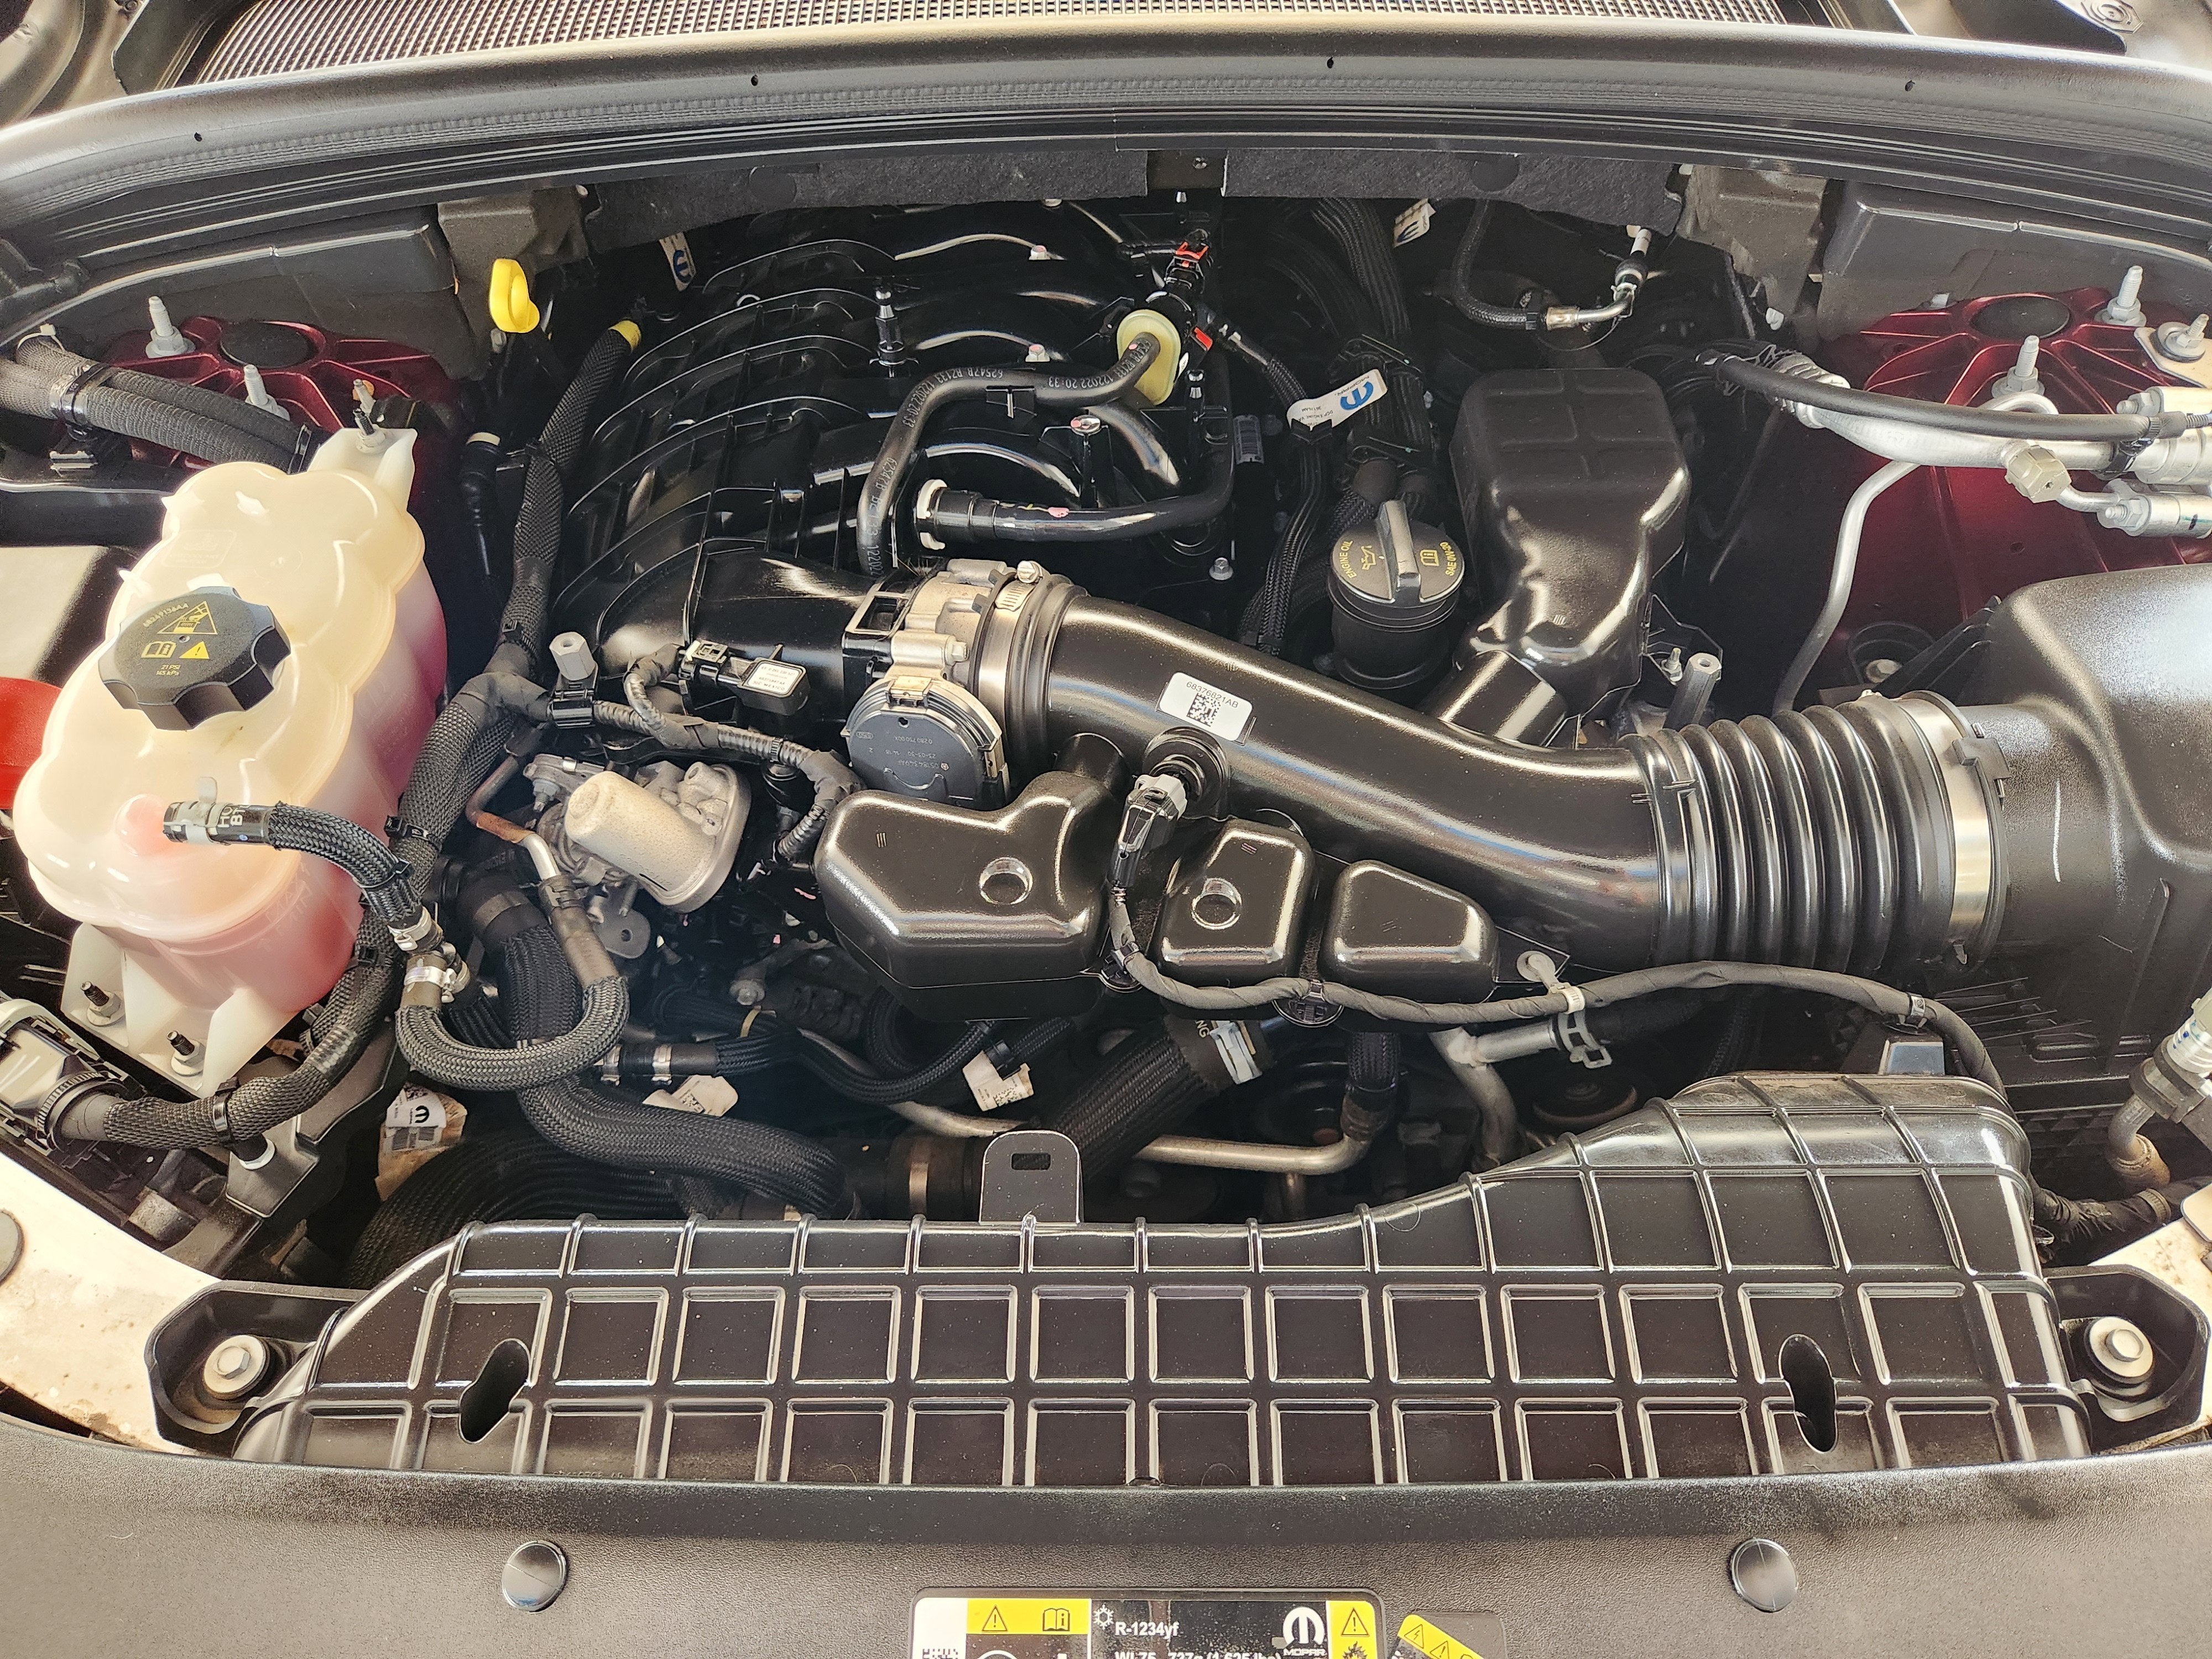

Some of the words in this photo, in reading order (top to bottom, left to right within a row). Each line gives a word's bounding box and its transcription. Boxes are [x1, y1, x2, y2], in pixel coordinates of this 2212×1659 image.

[1342, 540, 1353, 551] OIL
[1339, 551, 1357, 578] ENGINE
[1446, 563, 1457, 576] SAE
[1186, 681, 1239, 708] 68376821AB
[1115, 1623, 1179, 1639] R-1234yf
[1283, 1648, 1326, 1657] MOPAR
